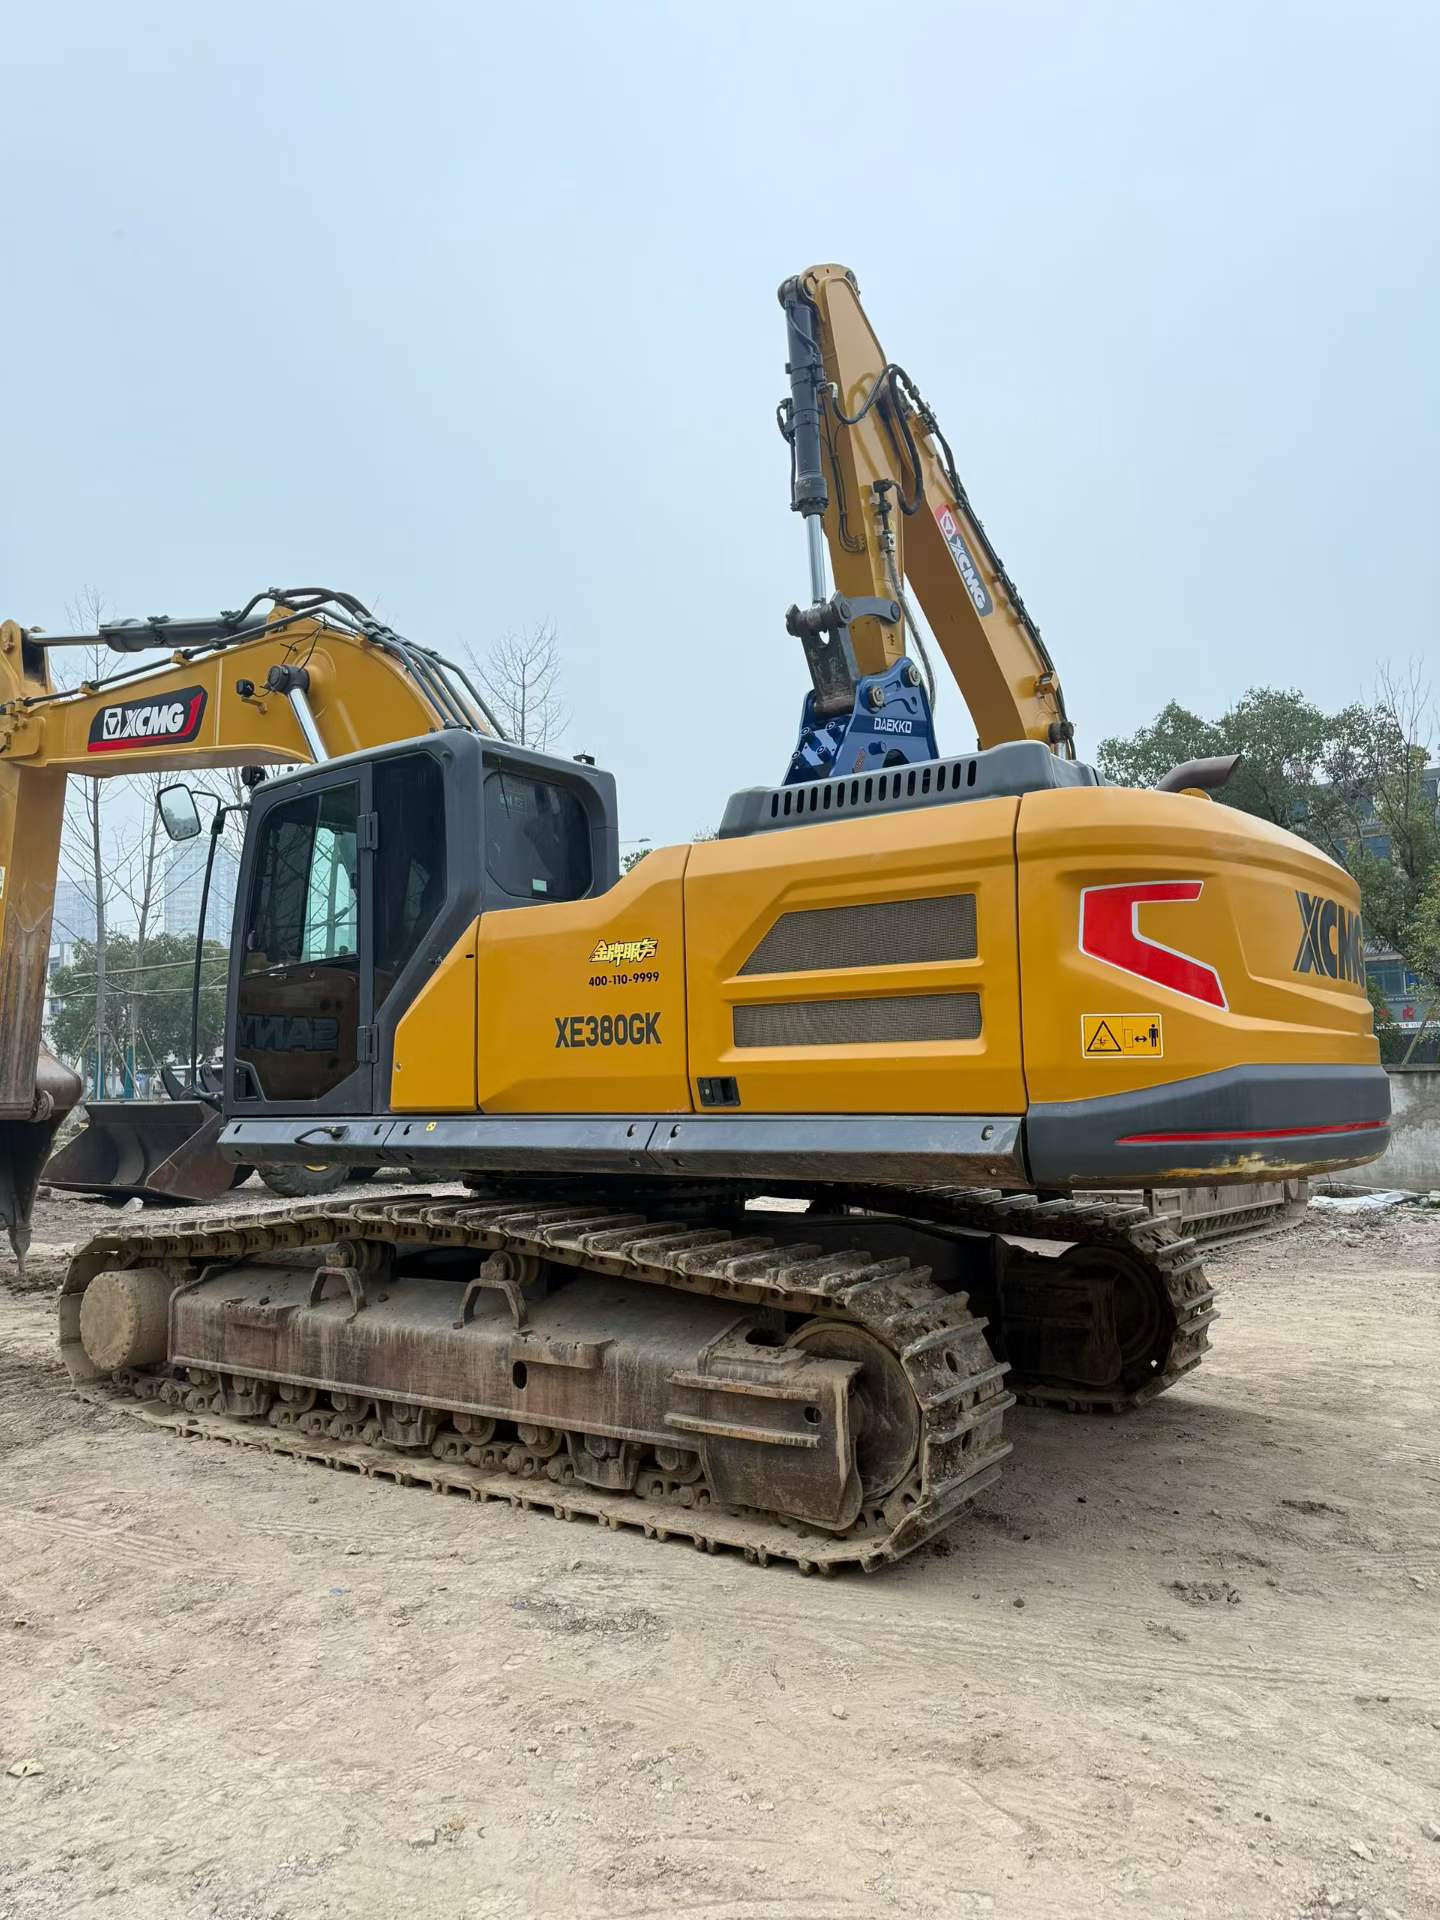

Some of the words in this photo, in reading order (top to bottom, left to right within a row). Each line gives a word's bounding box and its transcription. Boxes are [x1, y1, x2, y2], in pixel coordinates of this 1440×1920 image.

[950, 536, 986, 609] XCMG
[121, 703, 184, 738] XCMG
[589, 938, 658, 966] 金牌服务
[589, 972, 659, 987] 400-110-9999
[555, 1012, 662, 1048] XE380GK
